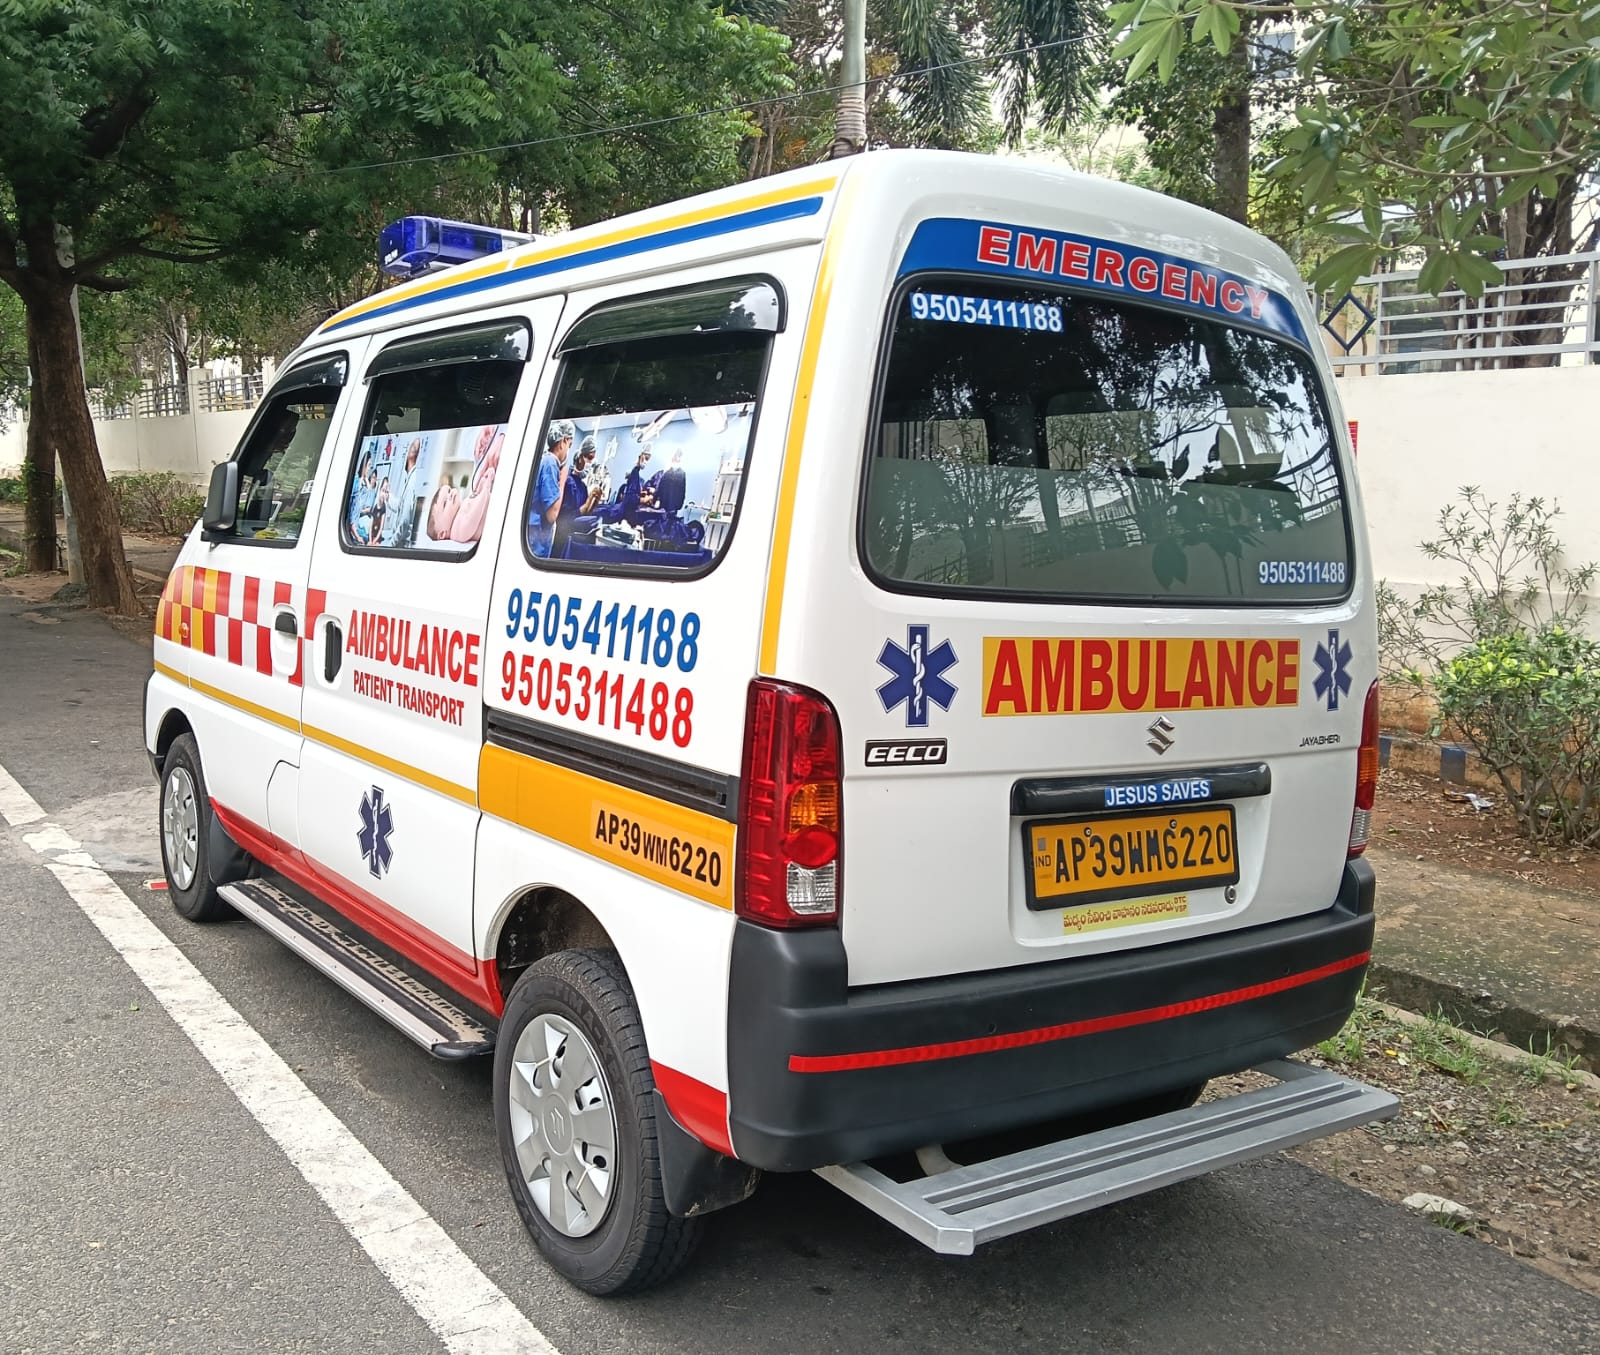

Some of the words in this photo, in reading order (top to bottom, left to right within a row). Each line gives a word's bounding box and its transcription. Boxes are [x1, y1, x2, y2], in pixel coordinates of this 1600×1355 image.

[976, 225, 1268, 319] EMERGENCY
[911, 293, 1062, 332] 9505411188
[1258, 561, 1345, 584] 9505311488
[345, 609, 480, 687] AMBULANCE
[505, 588, 700, 672] 9505411188
[353, 669, 394, 704] PATIENT
[396, 682, 464, 727] TRANSPORT
[501, 650, 694, 748] 9505311488
[984, 639, 1298, 714] AMBULANCE
[866, 745, 945, 763] EECO
[1106, 785, 1157, 806] JESUS
[1161, 780, 1209, 801] SAVES
[1035, 854, 1050, 867] IND
